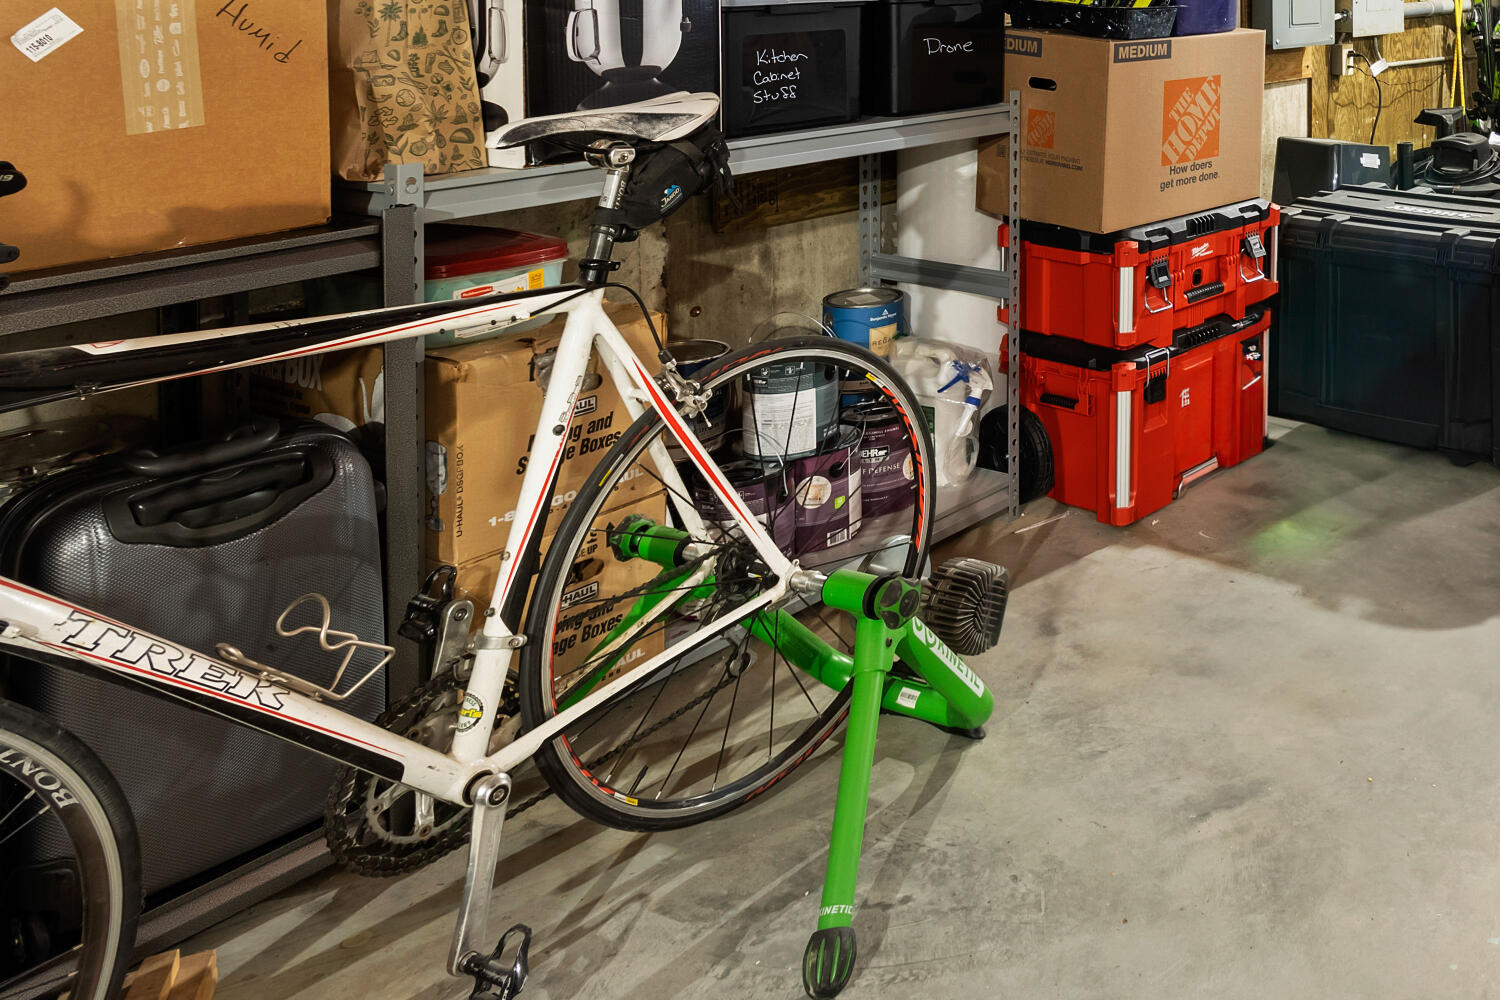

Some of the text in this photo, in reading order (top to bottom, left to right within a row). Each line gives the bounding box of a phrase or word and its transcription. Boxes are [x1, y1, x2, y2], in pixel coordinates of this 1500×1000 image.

[923, 38, 975, 55] Drone
[1004, 37, 1038, 53] DIUM
[1118, 43, 1168, 60] MEDIUM
[756, 49, 808, 66] Kitchen
[753, 67, 801, 86] Cabinet
[1169, 87, 1194, 123] THE
[1162, 75, 1221, 164] HOME
[1185, 106, 1221, 161] DEPOT
[1169, 159, 1213, 176] How doers
[1160, 179, 1174, 192] get
[1176, 175, 1196, 187] more
[872, 336, 894, 346] REGA
[586, 411, 614, 438] and
[579, 430, 622, 458] Boxes
[580, 613, 624, 644] Boxes
[62, 609, 291, 711] TREK
[937, 640, 985, 690] KINETIC
